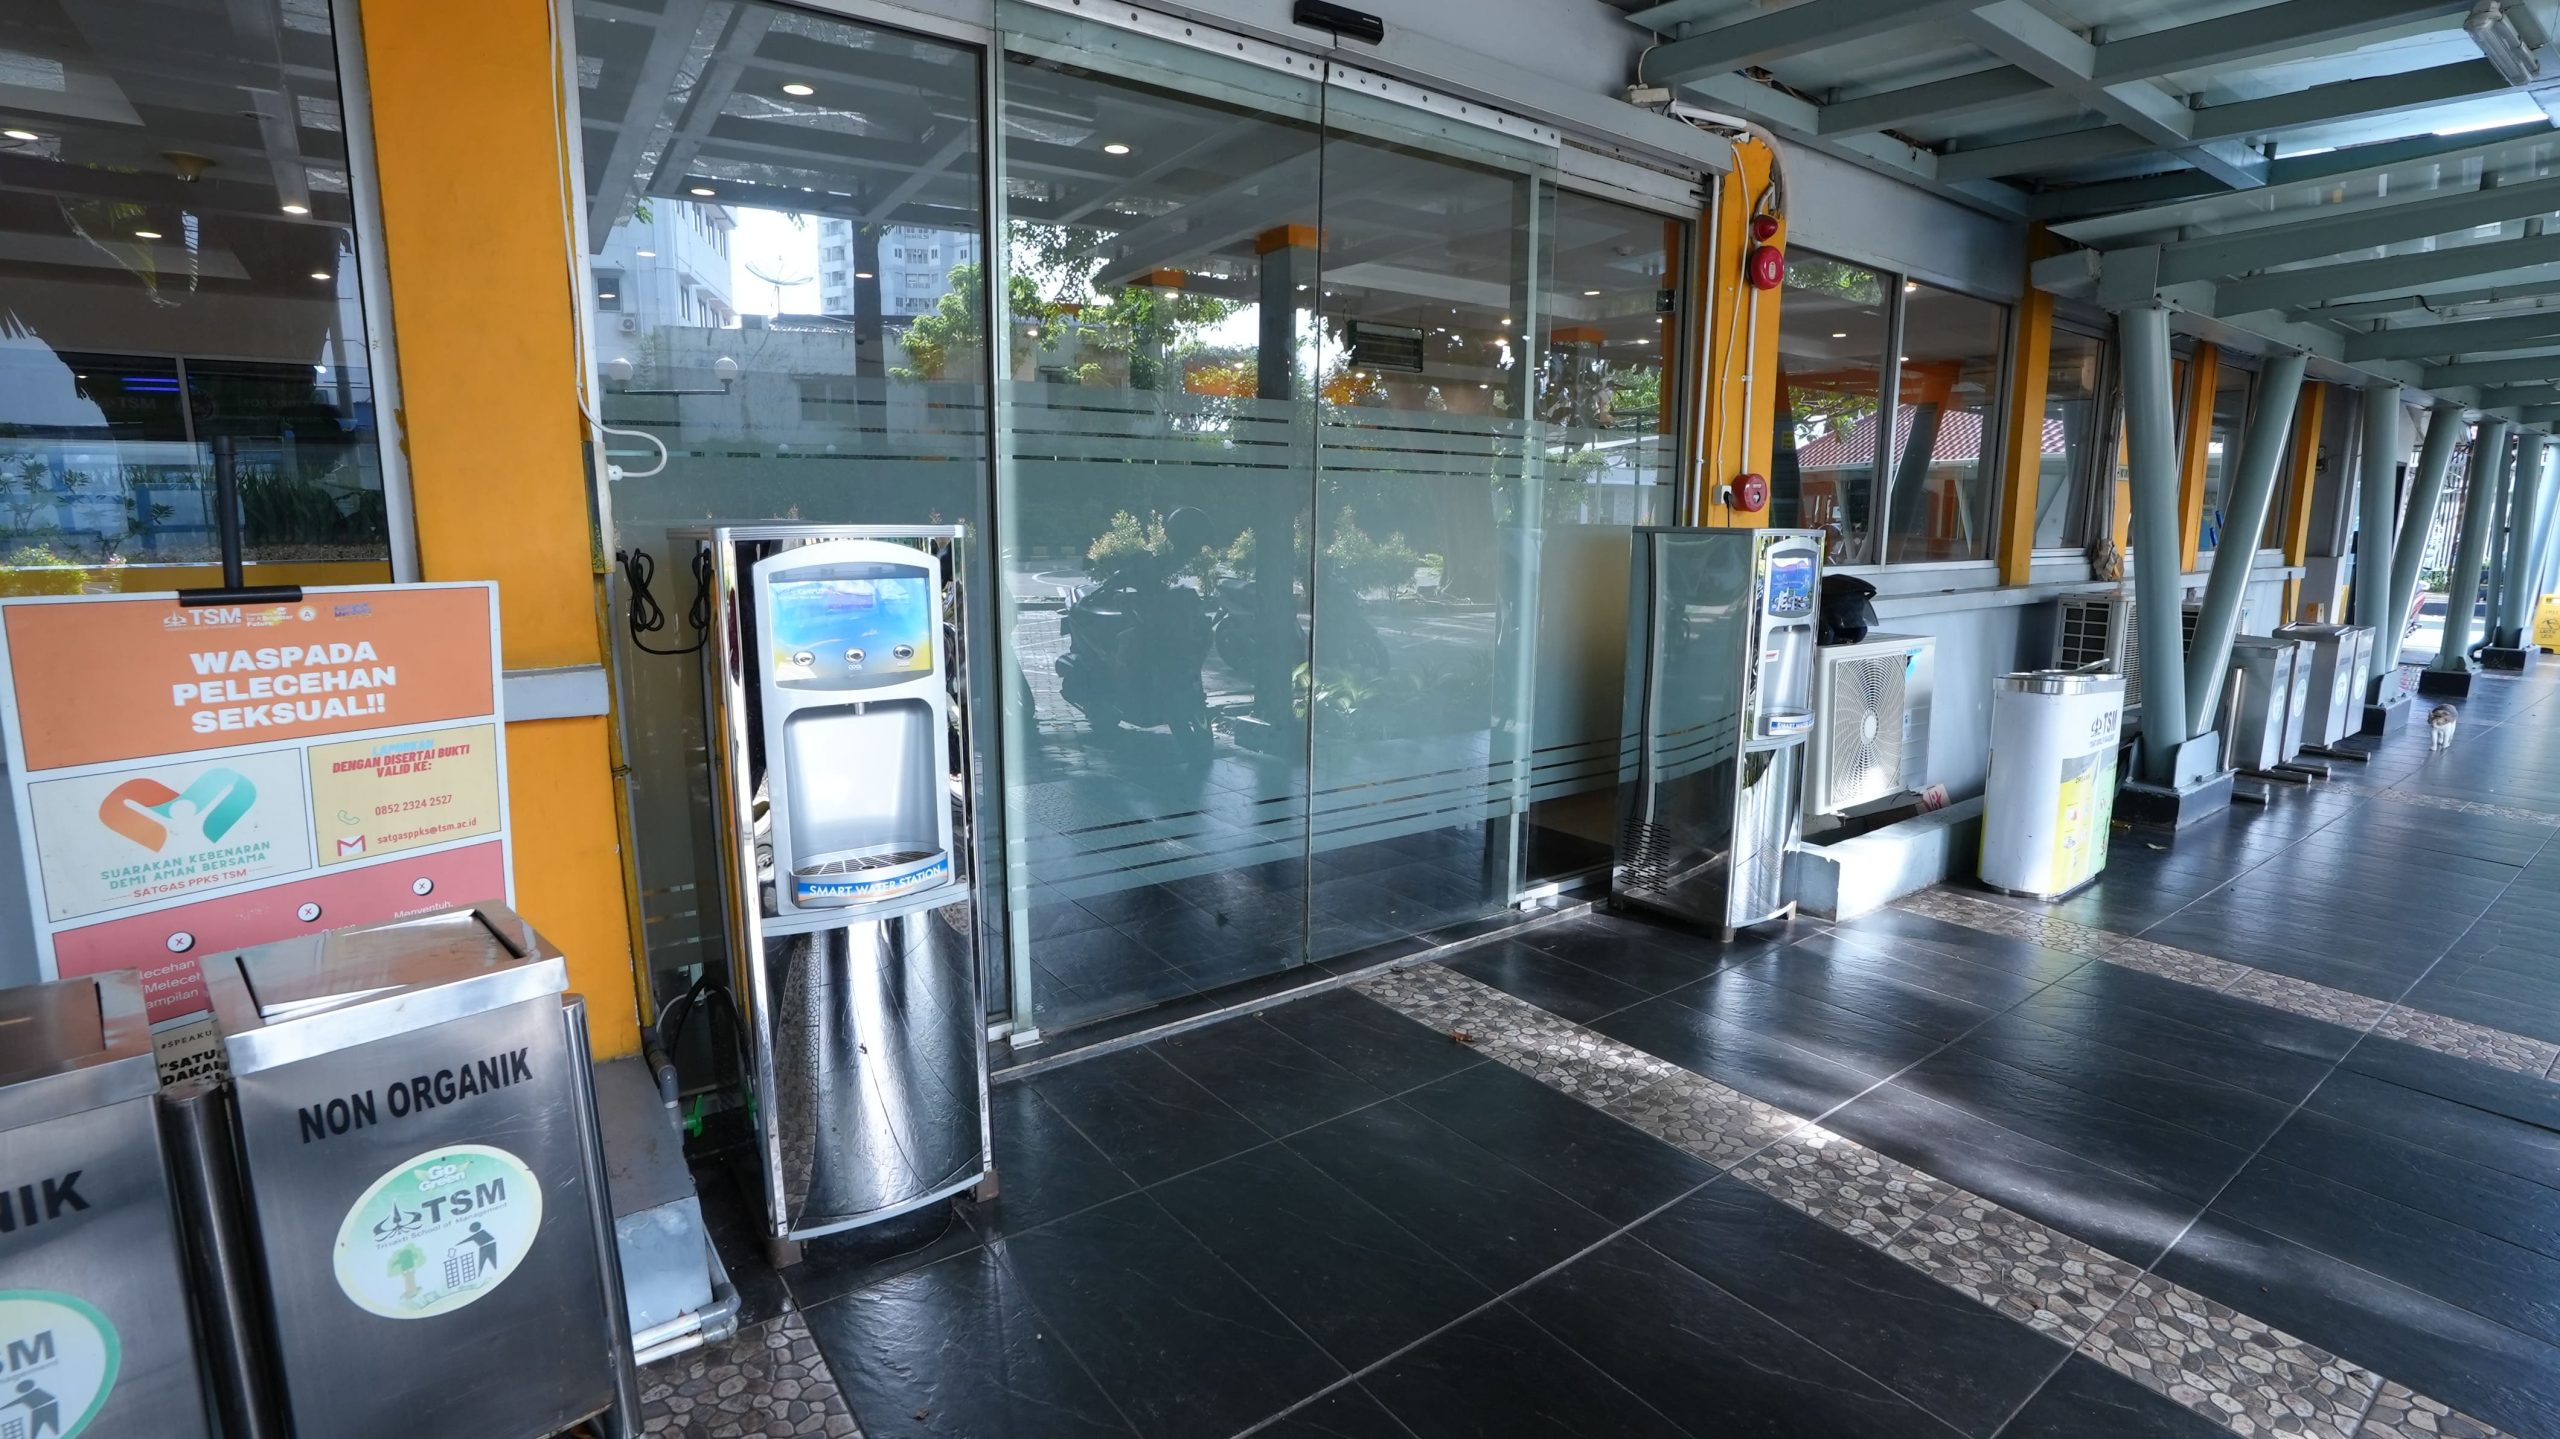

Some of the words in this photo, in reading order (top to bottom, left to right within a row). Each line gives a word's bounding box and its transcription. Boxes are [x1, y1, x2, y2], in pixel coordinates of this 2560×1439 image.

[189, 608, 242, 625] TSM
[189, 641, 378, 675] WASPADA
[172, 666, 396, 706] PELECEHAN
[191, 693, 386, 733] SEKSUAL!!
[2103, 709, 2118, 734] TSM
[332, 756, 381, 773] DENGAN
[383, 749, 436, 766] DISERTAI
[437, 744, 470, 759] BUKTI
[376, 762, 411, 778] VALID
[413, 761, 432, 773] KE:
[375, 804, 400, 816] 0852
[403, 799, 427, 811] 2324
[430, 794, 452, 807] 2527
[377, 817, 477, 845] satgasppks@tsm.ac.id
[101, 857, 182, 880] SUARAKAN
[189, 841, 271, 863] KEBENARAN
[109, 874, 147, 890] DEMI
[153, 866, 195, 882] AMAN
[202, 852, 267, 872] BERSAMA
[133, 881, 186, 898] SATGAS
[188, 874, 219, 887] PPKS
[222, 869, 247, 880] TSM
[809, 885, 853, 897] SMART
[856, 881, 896, 896] WATER
[898, 864, 942, 887] STATION
[298, 1089, 377, 1144] NON
[387, 1046, 533, 1118] ORGANIK
[418, 1172, 465, 1192] Green
[421, 1177, 506, 1225] TSM
[410, 1225, 441, 1239] School
[455, 1202, 508, 1223] Management
